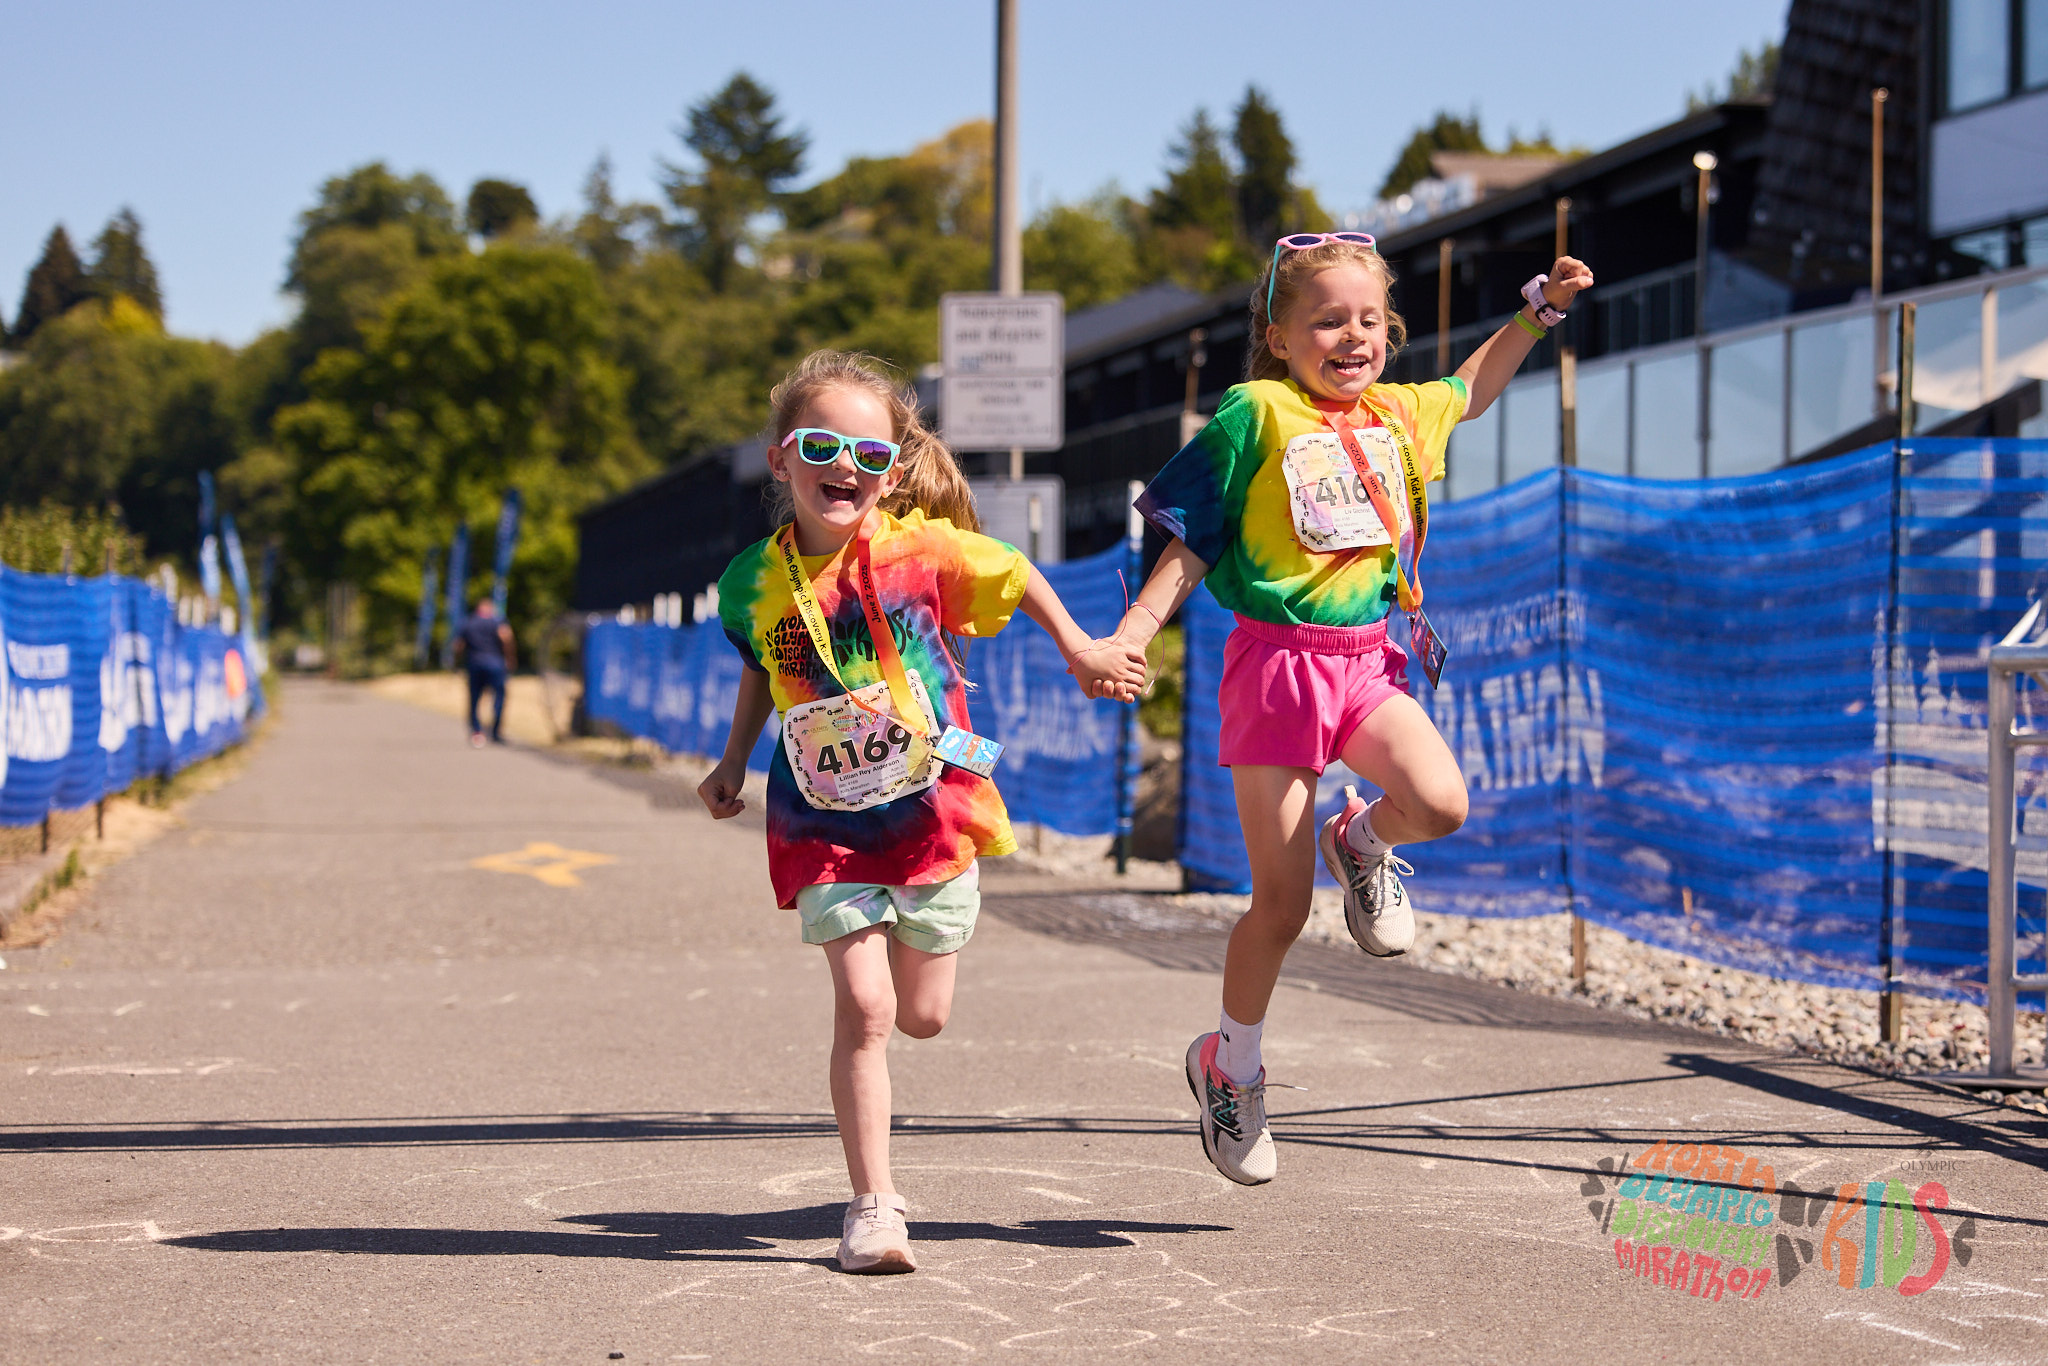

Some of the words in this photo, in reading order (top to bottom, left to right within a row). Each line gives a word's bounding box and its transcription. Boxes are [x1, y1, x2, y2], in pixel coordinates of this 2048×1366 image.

[1349, 442, 1365, 467] 2025
[1397, 435, 1416, 477] Discovery
[1368, 475, 1381, 495] June
[1410, 476, 1420, 495] Kids
[1414, 496, 1424, 539] Marathon
[783, 541, 795, 566] North
[788, 564, 807, 600] Olympic
[861, 564, 872, 591] 2025
[802, 599, 824, 643] Discovery
[870, 601, 882, 623] June
[817, 724, 912, 775] 4169
[839, 771, 859, 782] Lillian
